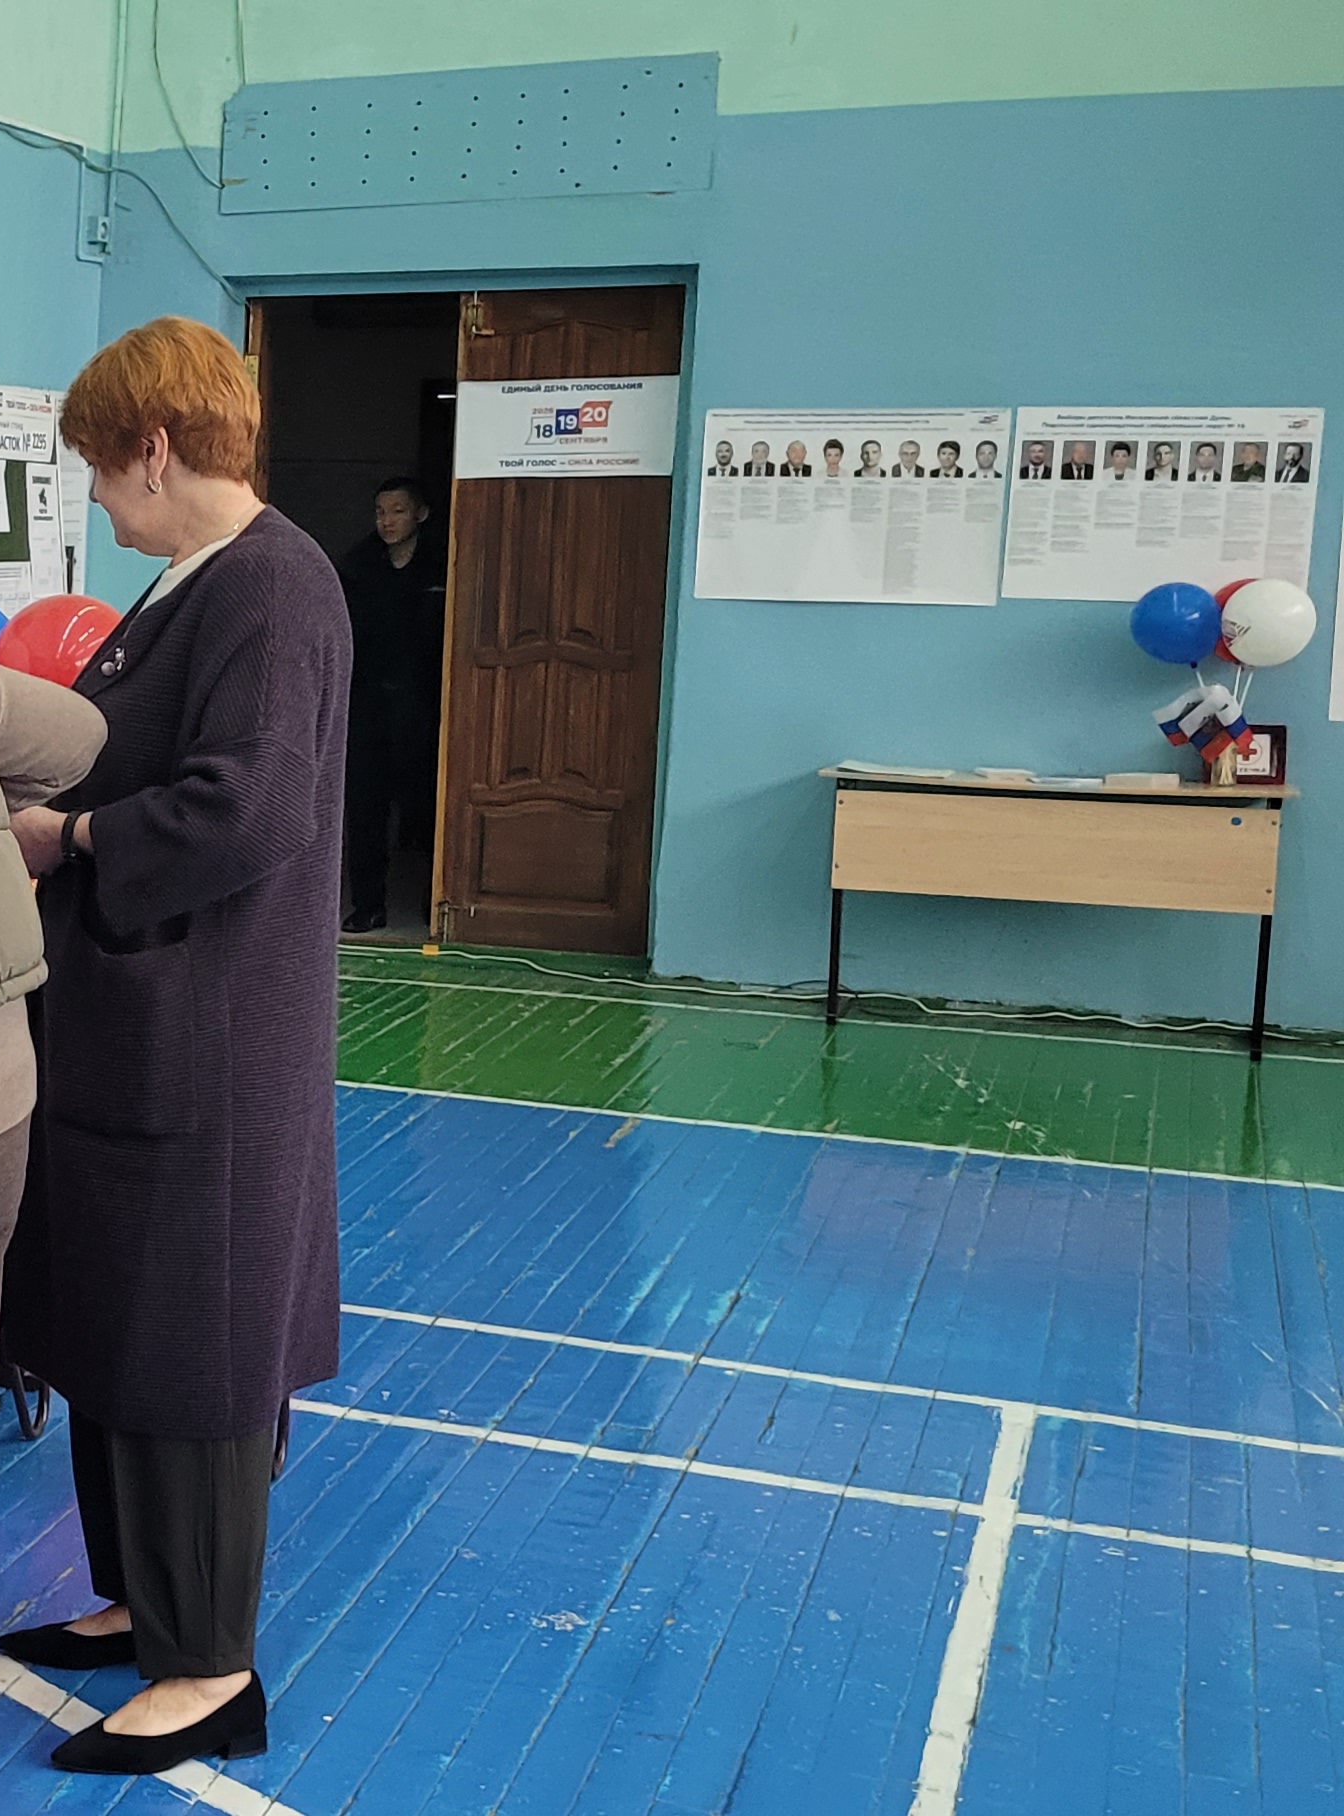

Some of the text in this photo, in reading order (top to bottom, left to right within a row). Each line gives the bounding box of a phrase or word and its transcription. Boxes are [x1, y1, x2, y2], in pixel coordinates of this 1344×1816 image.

[502, 382, 643, 394] ЕДИНЫЙ ДЕНЬ ГОЛОСОВАНИЯ
[534, 407, 607, 438] 18 19 20
[22, 432, 30, 452] №
[499, 459, 523, 467] ТВОЙ
[526, 459, 557, 467] ГОЛОС
